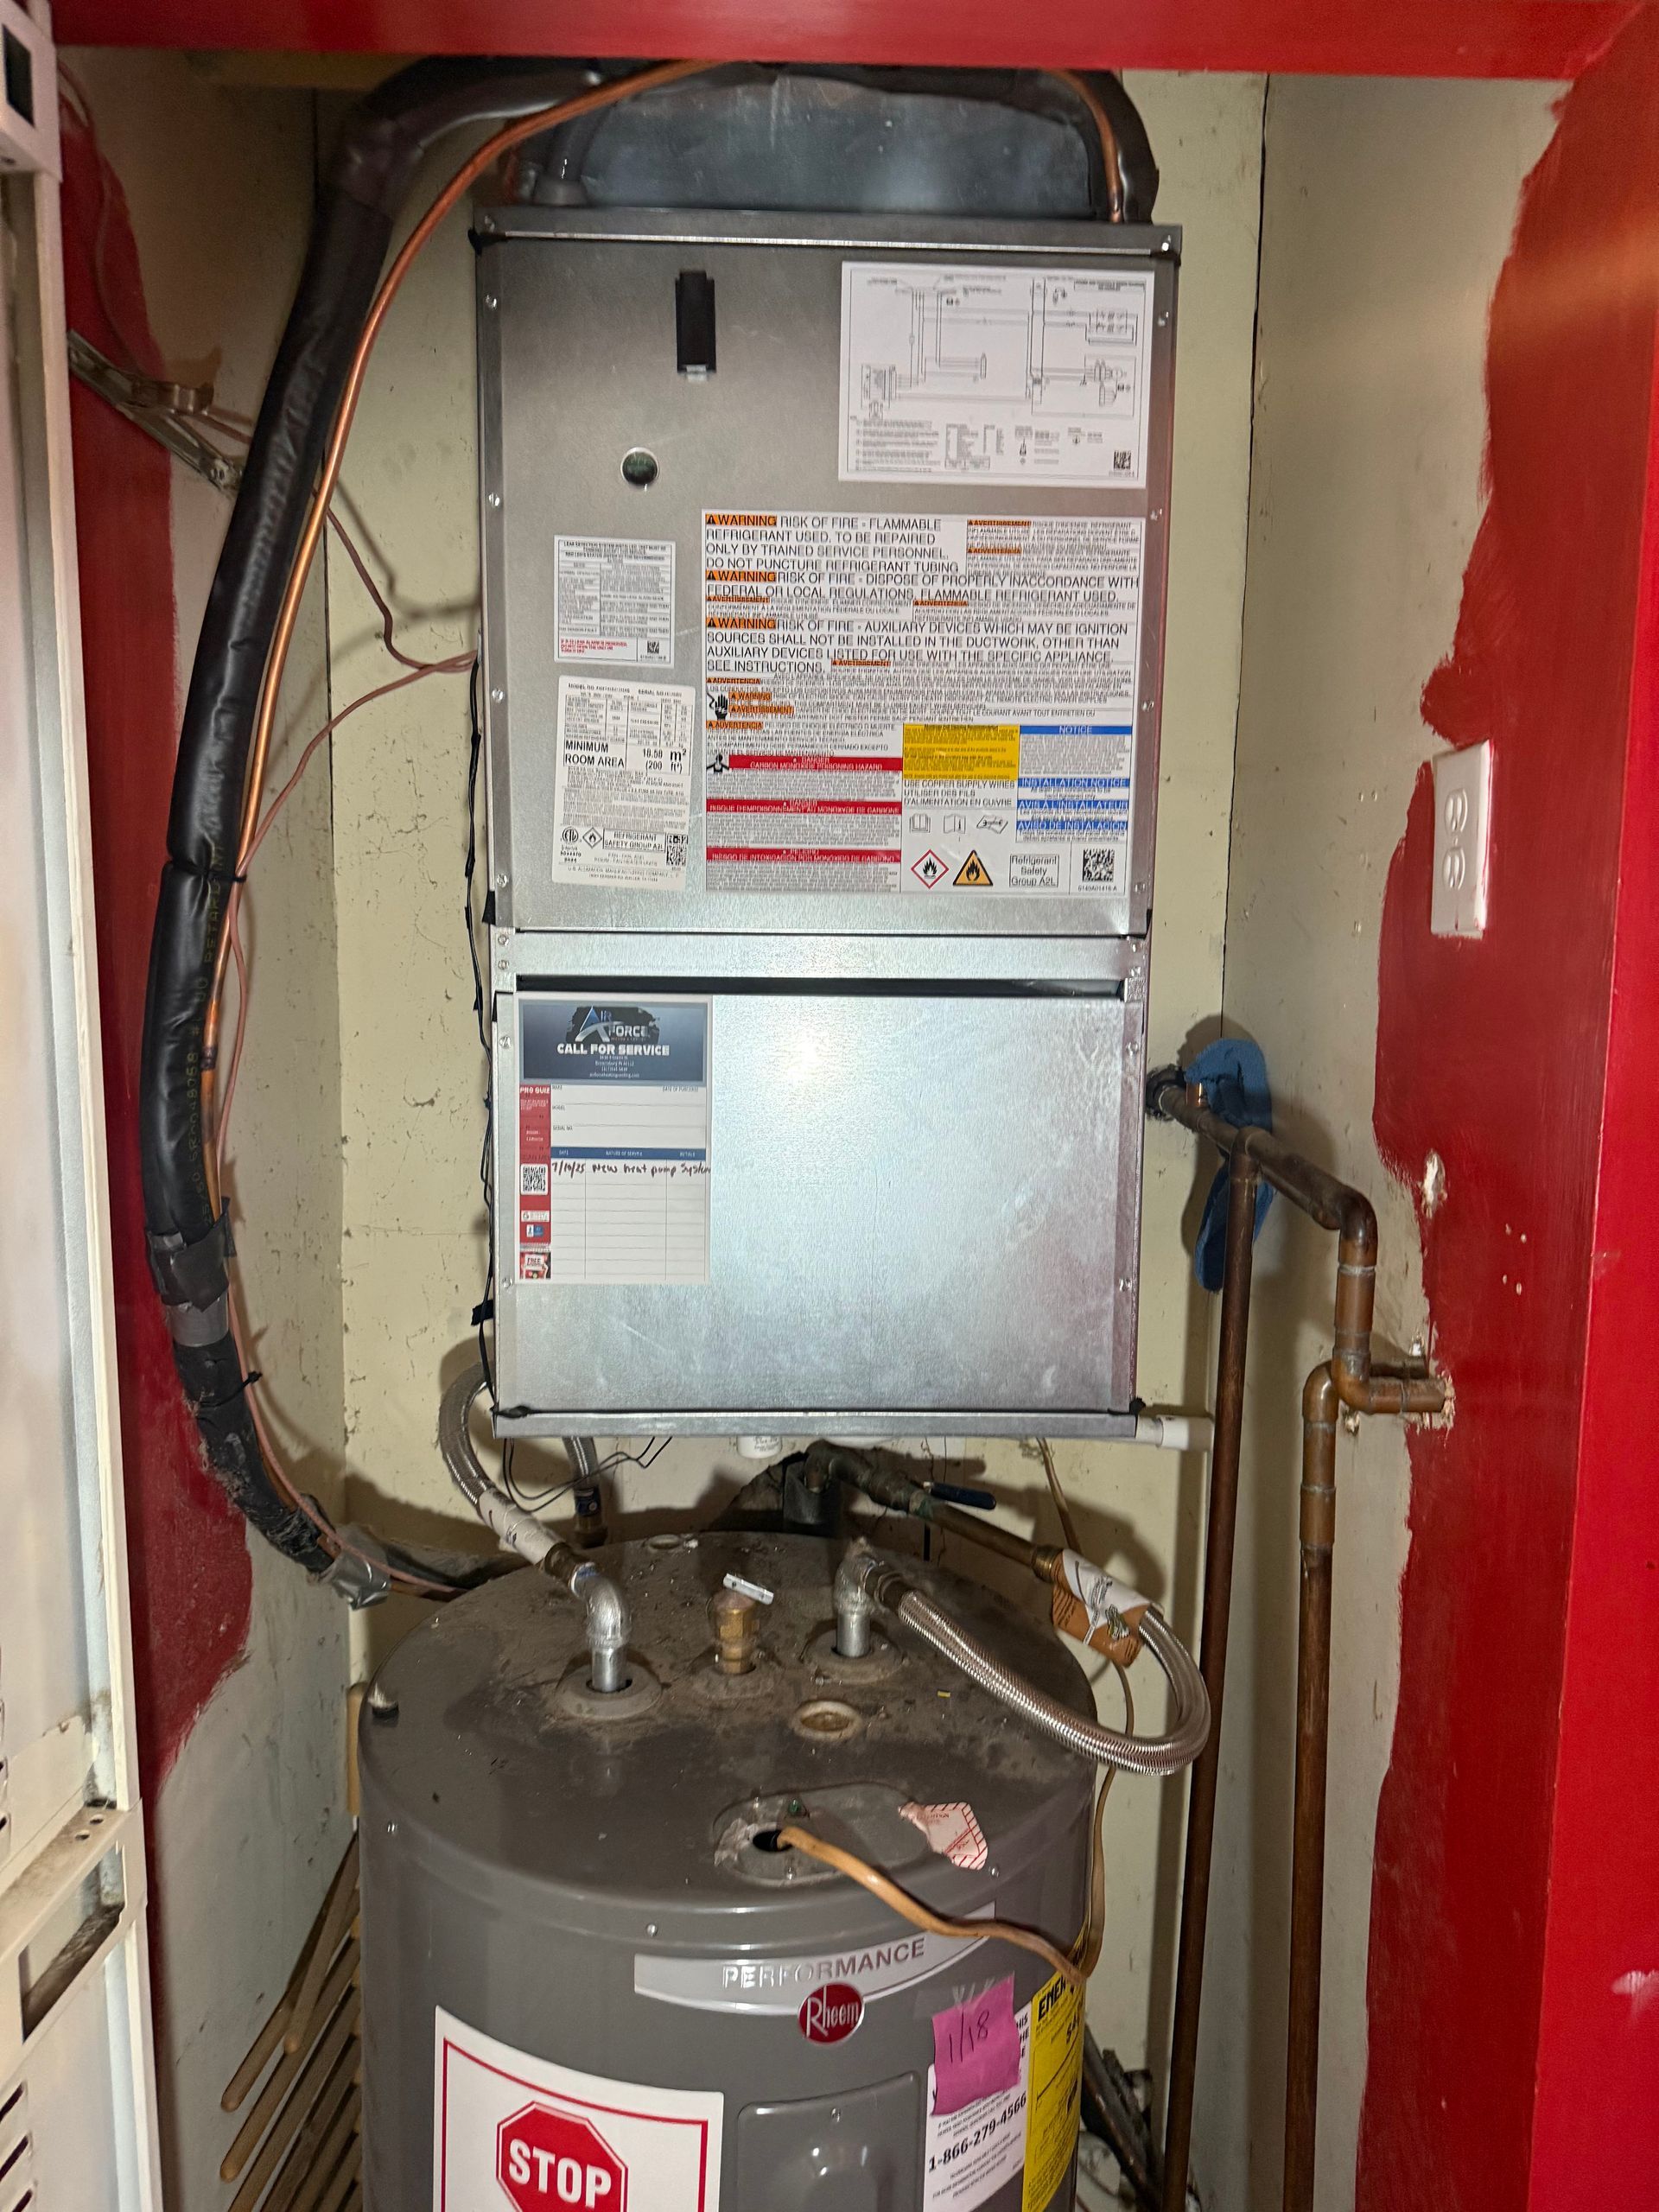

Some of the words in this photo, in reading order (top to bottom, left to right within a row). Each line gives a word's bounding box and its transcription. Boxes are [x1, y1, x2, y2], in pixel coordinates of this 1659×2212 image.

[718, 515, 777, 526] WARNING
[780, 517, 808, 528] RISK
[812, 518, 828, 529] OF
[832, 518, 858, 529] FIRE
[870, 518, 941, 531] FLAMMABLE
[706, 529, 792, 542] REFRIGERANT
[836, 531, 852, 543] TO
[856, 531, 871, 543] BE
[875, 532, 935, 545] REPAIRED
[706, 543, 738, 554] ONLY
[742, 543, 757, 555] BY
[761, 544, 813, 556] TRAINED
[817, 545, 869, 557] SERVICE
[706, 557, 723, 569] DO
[728, 558, 751, 569] NOT
[757, 558, 821, 570] PUNCTURE
[826, 560, 910, 572] REFRIGERANT
[914, 561, 958, 573] TUBING
[719, 571, 776, 582] WARNING
[779, 572, 804, 583] RISK
[809, 573, 824, 583] OF
[829, 573, 855, 584] FIRE
[867, 574, 918, 586] DISPOSE
[922, 575, 938, 586] OF
[942, 575, 1006, 587] PROPERLY
[1108, 575, 1139, 588] WITH
[707, 584, 761, 596] FEDERAL
[766, 586, 783, 597] OR
[786, 586, 824, 598] LOCAL
[920, 588, 991, 601] FLAMMABLE
[995, 589, 1079, 602] REFRIGERANT
[719, 618, 776, 629] WARNING
[778, 620, 804, 631] RISK
[807, 620, 823, 632] OF
[828, 620, 855, 632] FIRE
[865, 621, 925, 633] AUXILIARY
[929, 622, 981, 634] DEVICES
[984, 623, 1024, 635] WHICH
[1027, 623, 1053, 635] MAY
[1057, 623, 1071, 635] BE
[1076, 624, 1128, 635] IGNITION
[707, 632, 766, 644] SOURCES
[769, 633, 806, 645] SHALL
[810, 634, 835, 645] NOT
[838, 634, 853, 646] BE
[857, 635, 921, 647] INSTALLED
[925, 637, 936, 647] IN
[940, 637, 963, 648] THE
[1042, 637, 1084, 648] OTHER
[1087, 637, 1119, 649] THAN
[707, 647, 768, 658] AUXILIARY
[772, 648, 823, 659] DEVICES
[827, 649, 868, 661] LISTED
[872, 649, 896, 661] FOR
[899, 650, 923, 662] USE
[927, 651, 957, 662] WITH
[961, 651, 983, 662] THE
[988, 651, 1041, 663] SPECIFIC
[707, 660, 730, 671] SEE
[1059, 726, 1092, 734] NOTICE
[565, 741, 608, 753] MINIMUM
[565, 753, 594, 766] ROOM
[598, 756, 625, 768] AREA
[957, 780, 988, 789] SUPPLY
[1012, 855, 1057, 866] Refrigerant
[1021, 867, 1047, 876] Safety
[1012, 877, 1036, 887] Group
[1039, 877, 1056, 887] A2L
[557, 1043, 588, 1055] CALL
[590, 1044, 615, 1055] FOR
[618, 1045, 670, 1056] SERVICE
[651, 1166, 677, 1178] pump
[722, 1938, 926, 1989] PERFORMANCE
[805, 1986, 860, 2038] Rheem
[928, 2089, 1027, 2173] 1-866-279-4566
[508, 2138, 613, 2209] STOP
